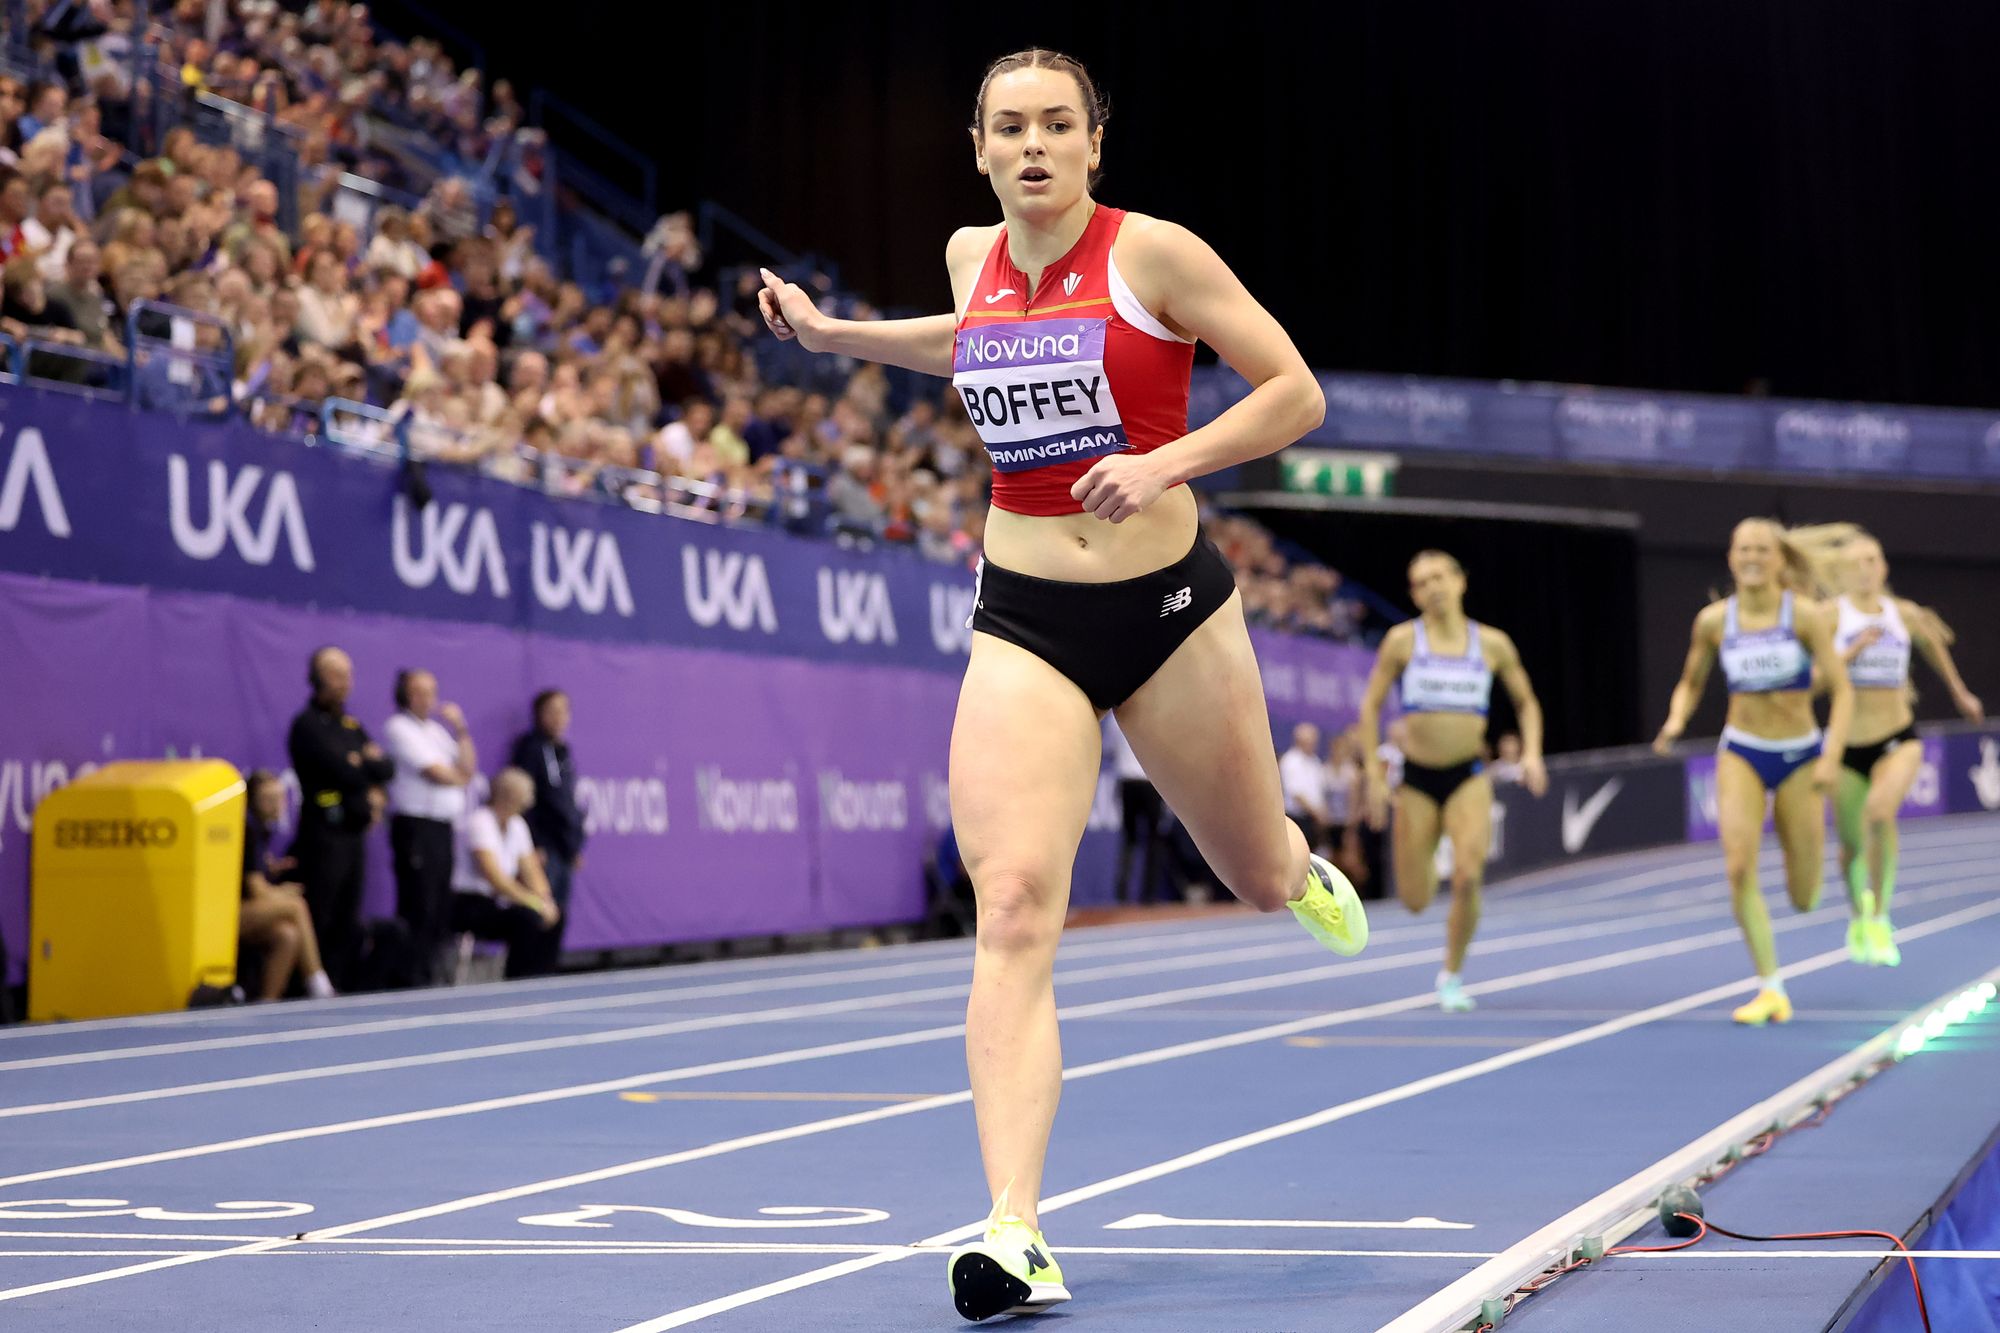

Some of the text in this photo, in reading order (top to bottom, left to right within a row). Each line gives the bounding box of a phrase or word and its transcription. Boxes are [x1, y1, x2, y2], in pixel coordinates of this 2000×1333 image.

[966, 333, 1079, 365] Novuna
[963, 376, 1100, 427] BOFFEY
[168, 453, 316, 573] UKA
[392, 492, 510, 598] UKA
[531, 521, 635, 617] UKA
[682, 544, 778, 634] UKA
[817, 566, 898, 645] UKA
[54, 817, 178, 849] SEIKO
